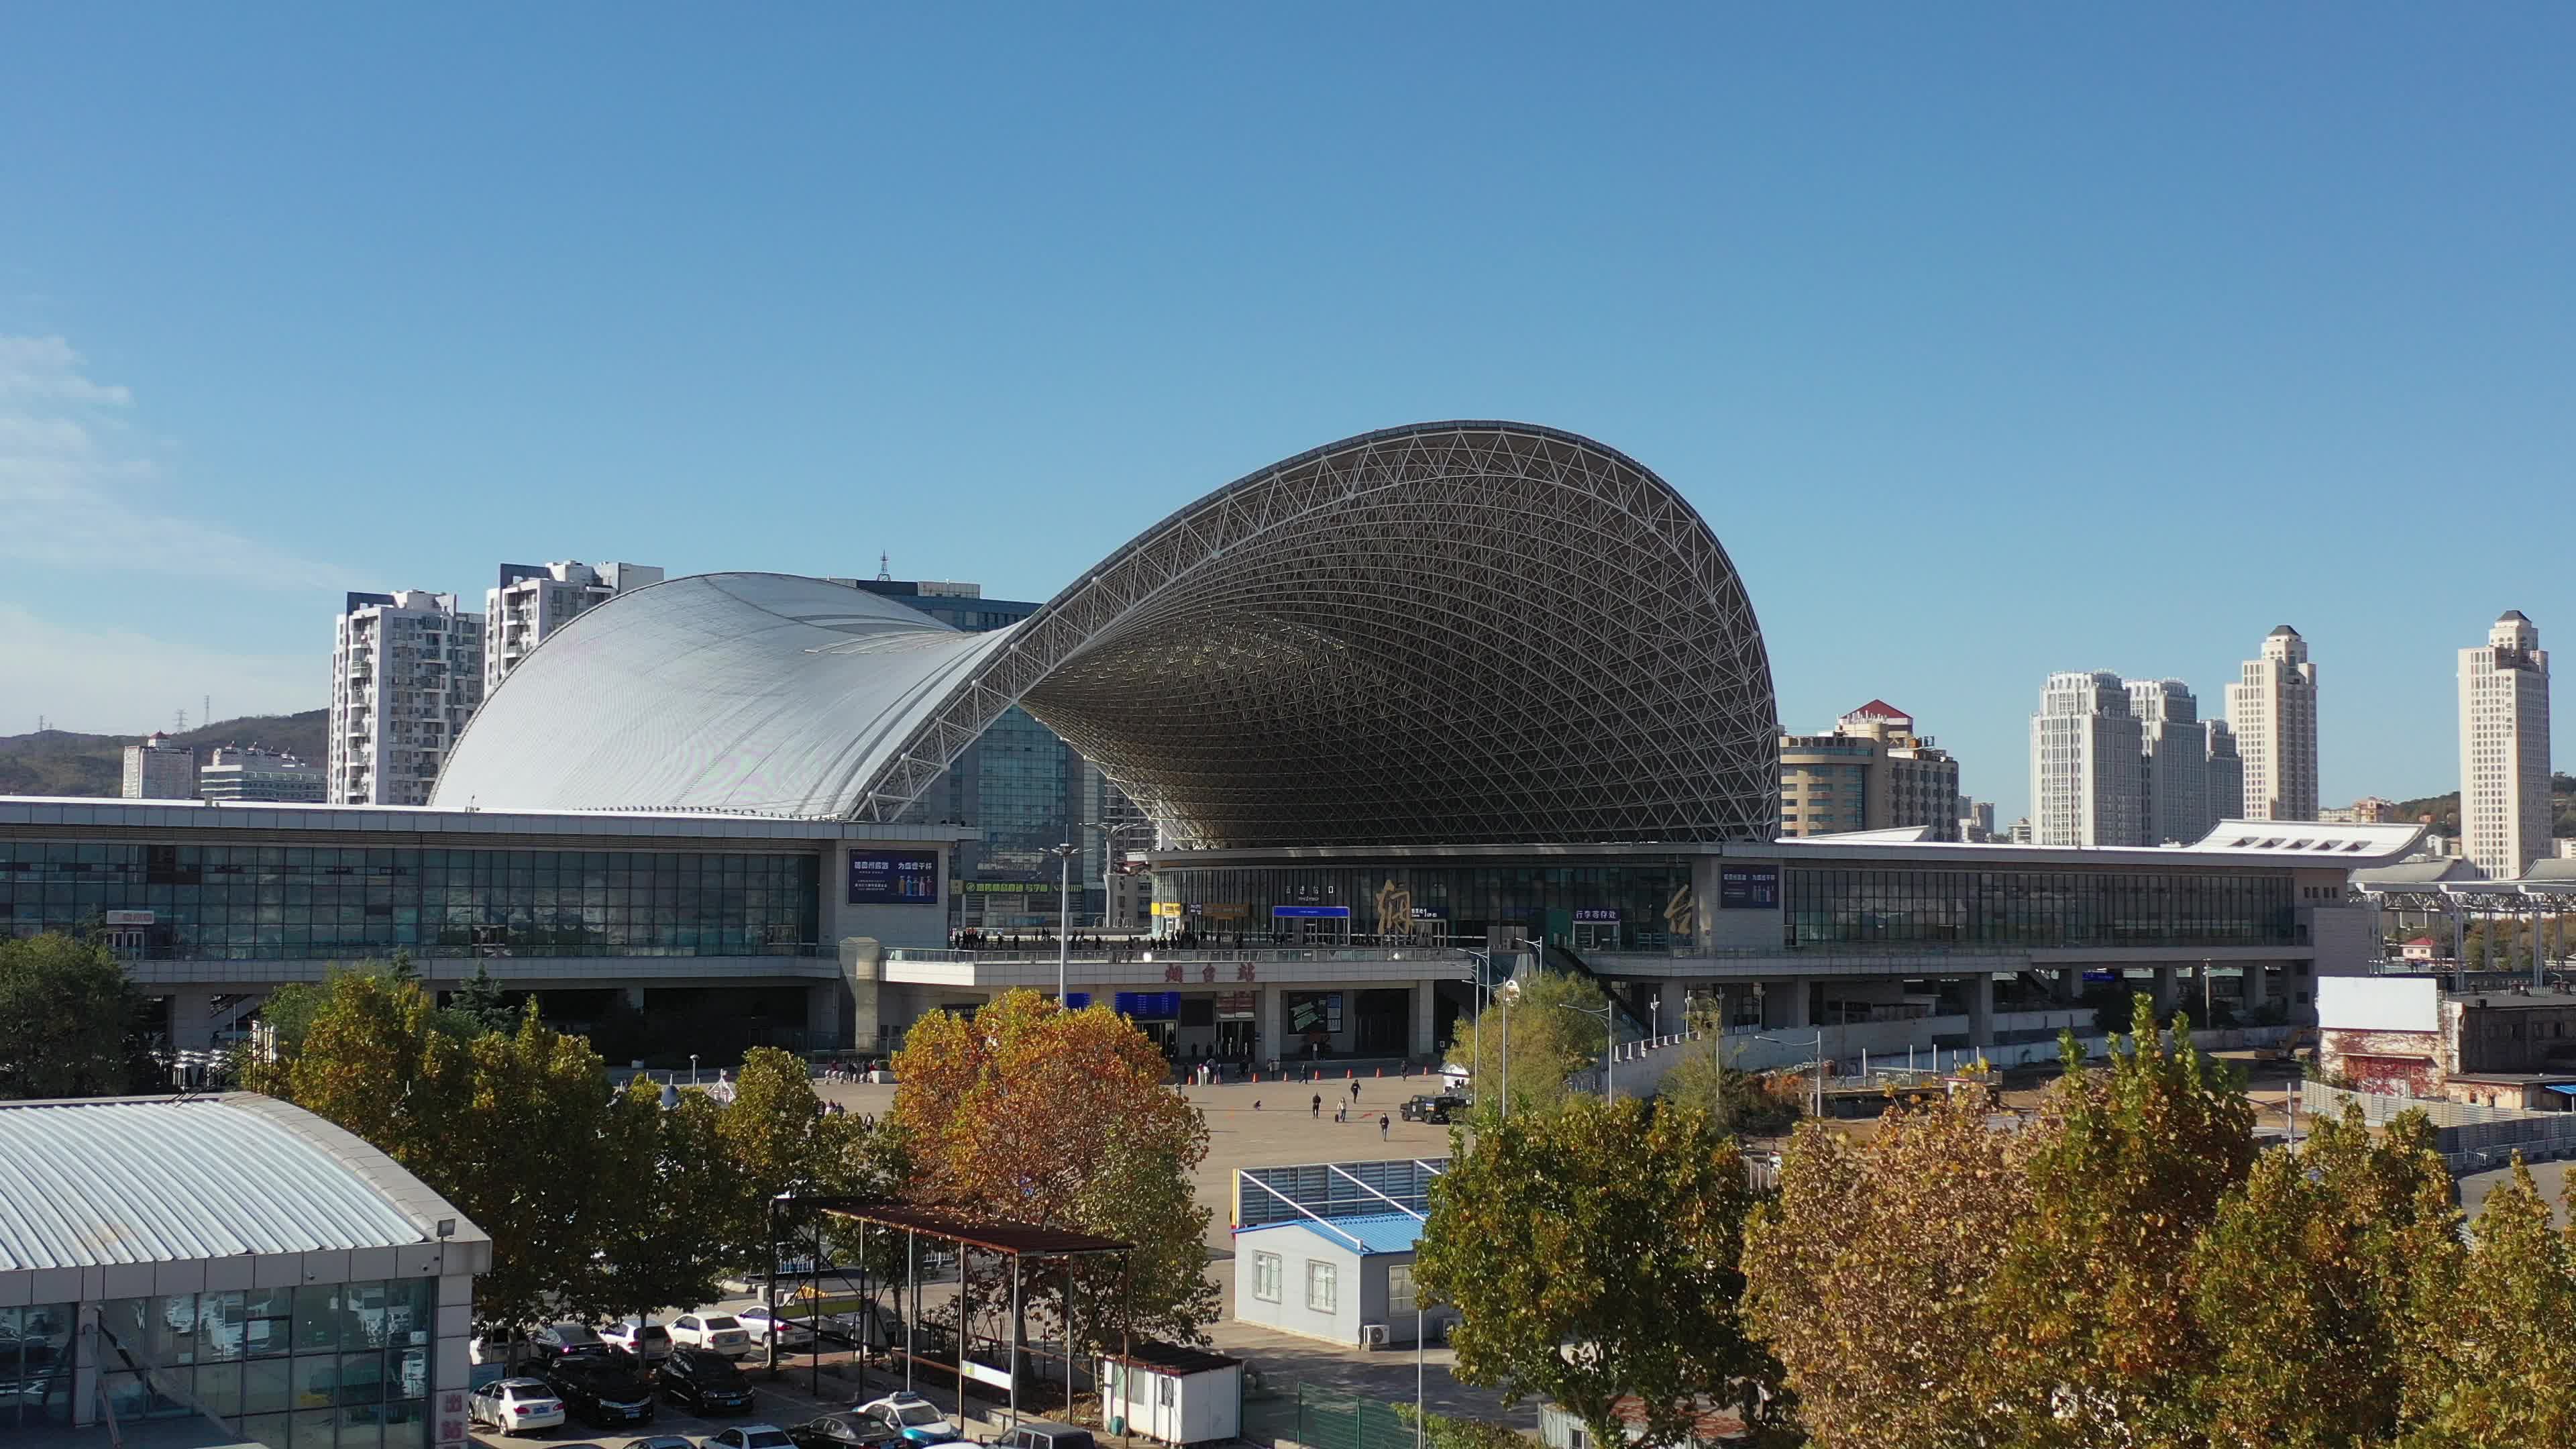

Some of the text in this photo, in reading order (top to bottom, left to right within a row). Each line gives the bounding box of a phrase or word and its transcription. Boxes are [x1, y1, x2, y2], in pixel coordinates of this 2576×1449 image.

[1576, 910, 1616, 919] 行李寄存处
